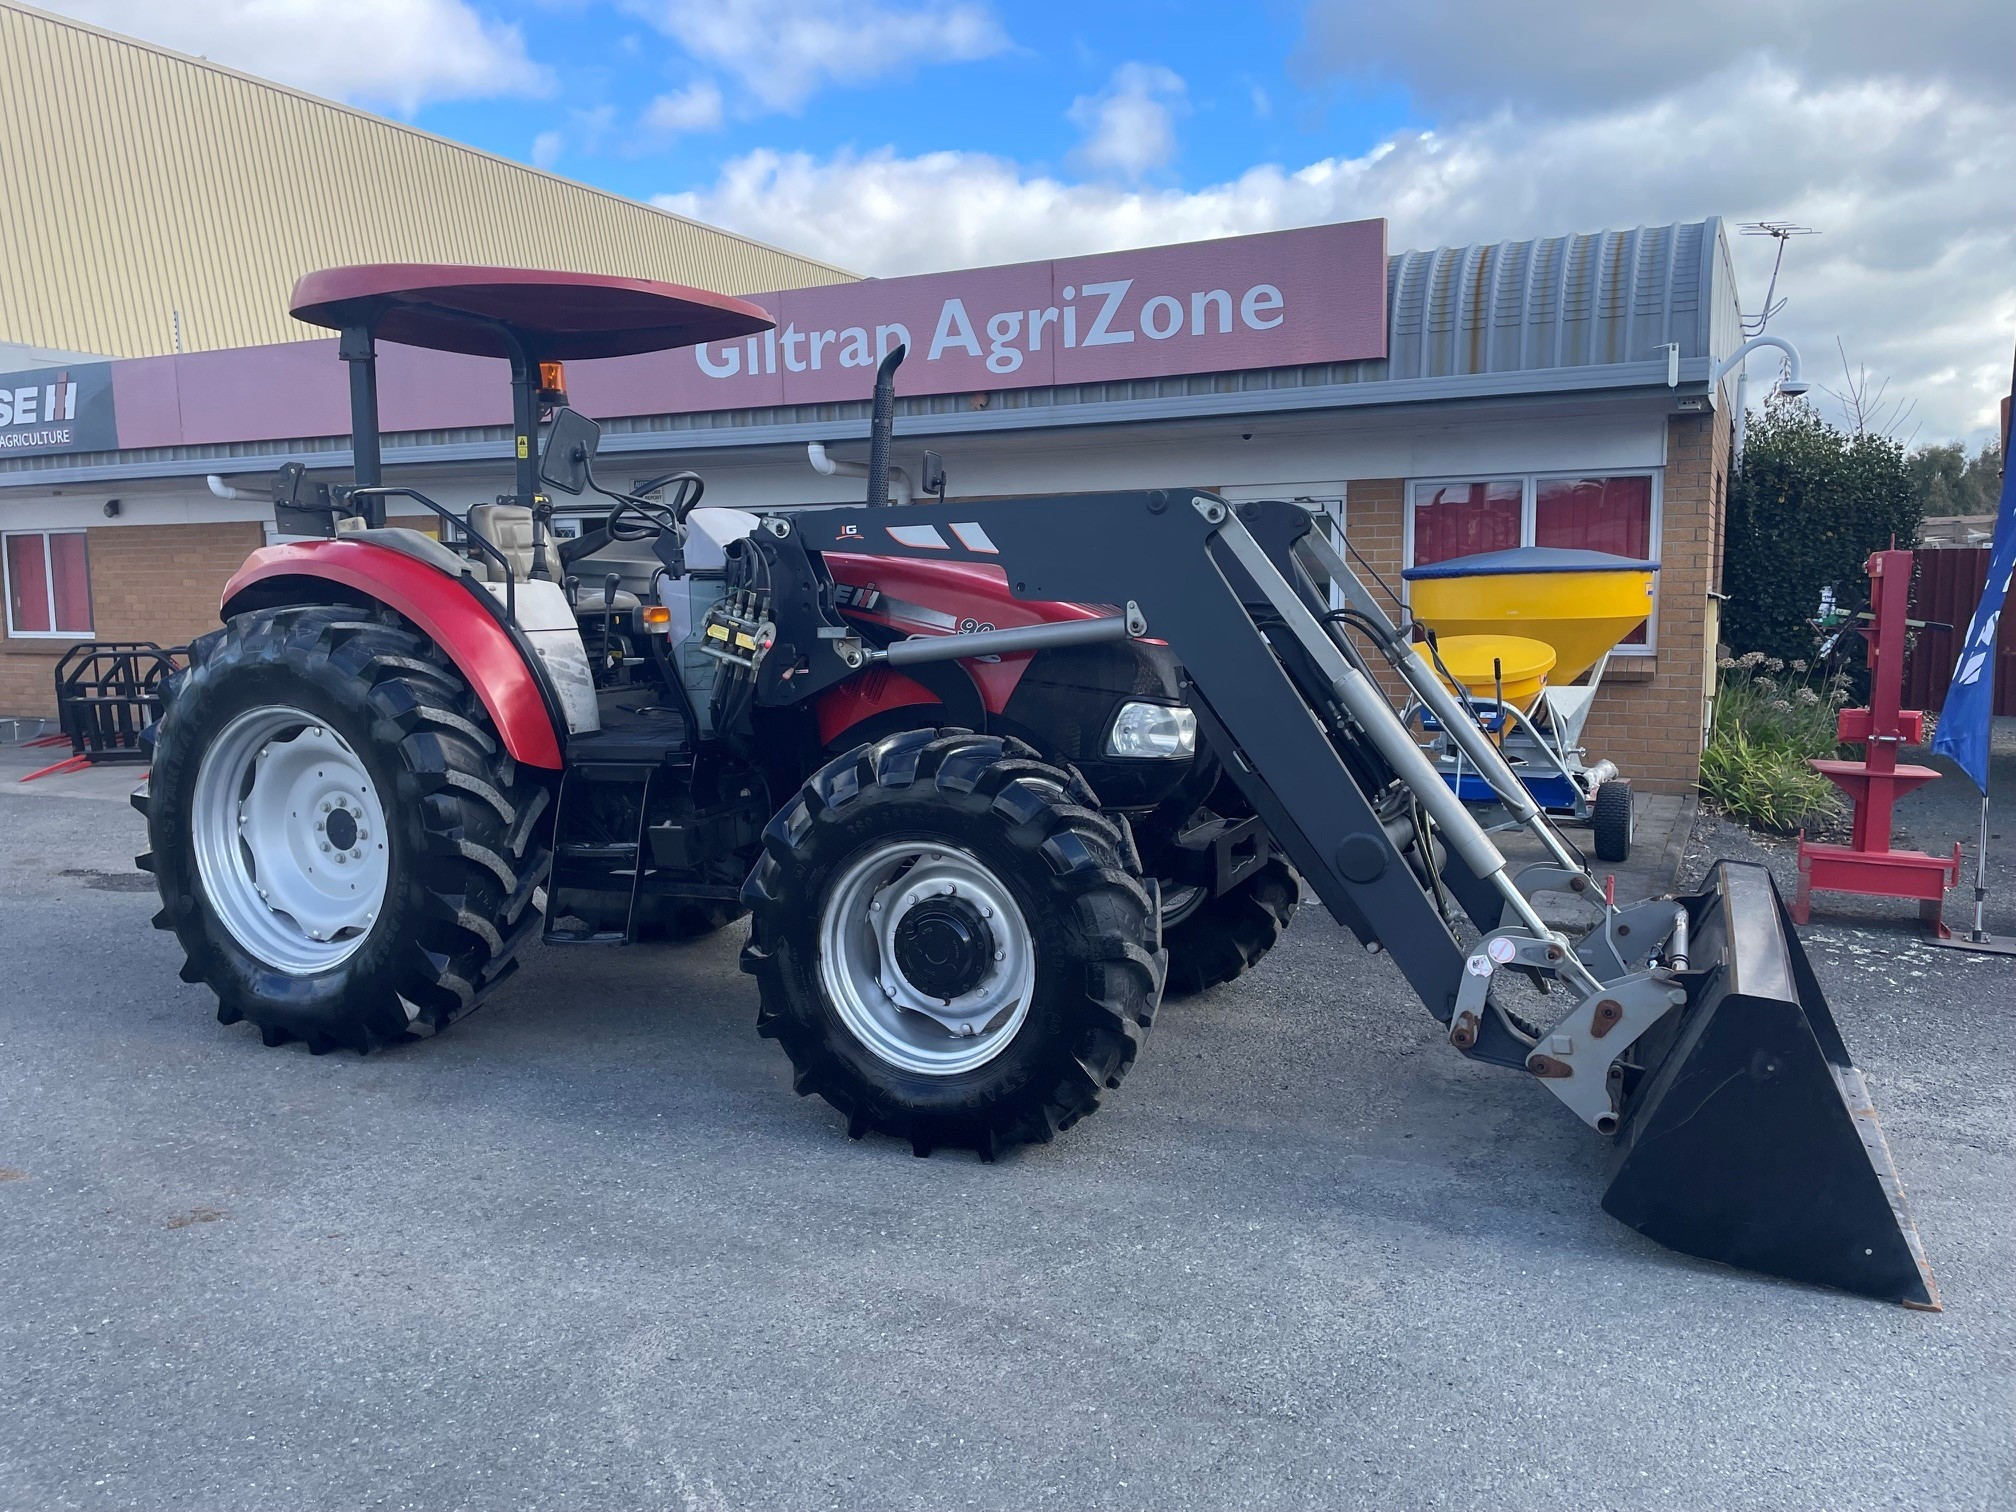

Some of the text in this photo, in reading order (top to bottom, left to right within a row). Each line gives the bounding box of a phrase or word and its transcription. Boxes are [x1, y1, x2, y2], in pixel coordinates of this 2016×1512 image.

[694, 278, 1284, 379] Giltrap AgriZone
[0, 429, 71, 448] AGRICULTURE
